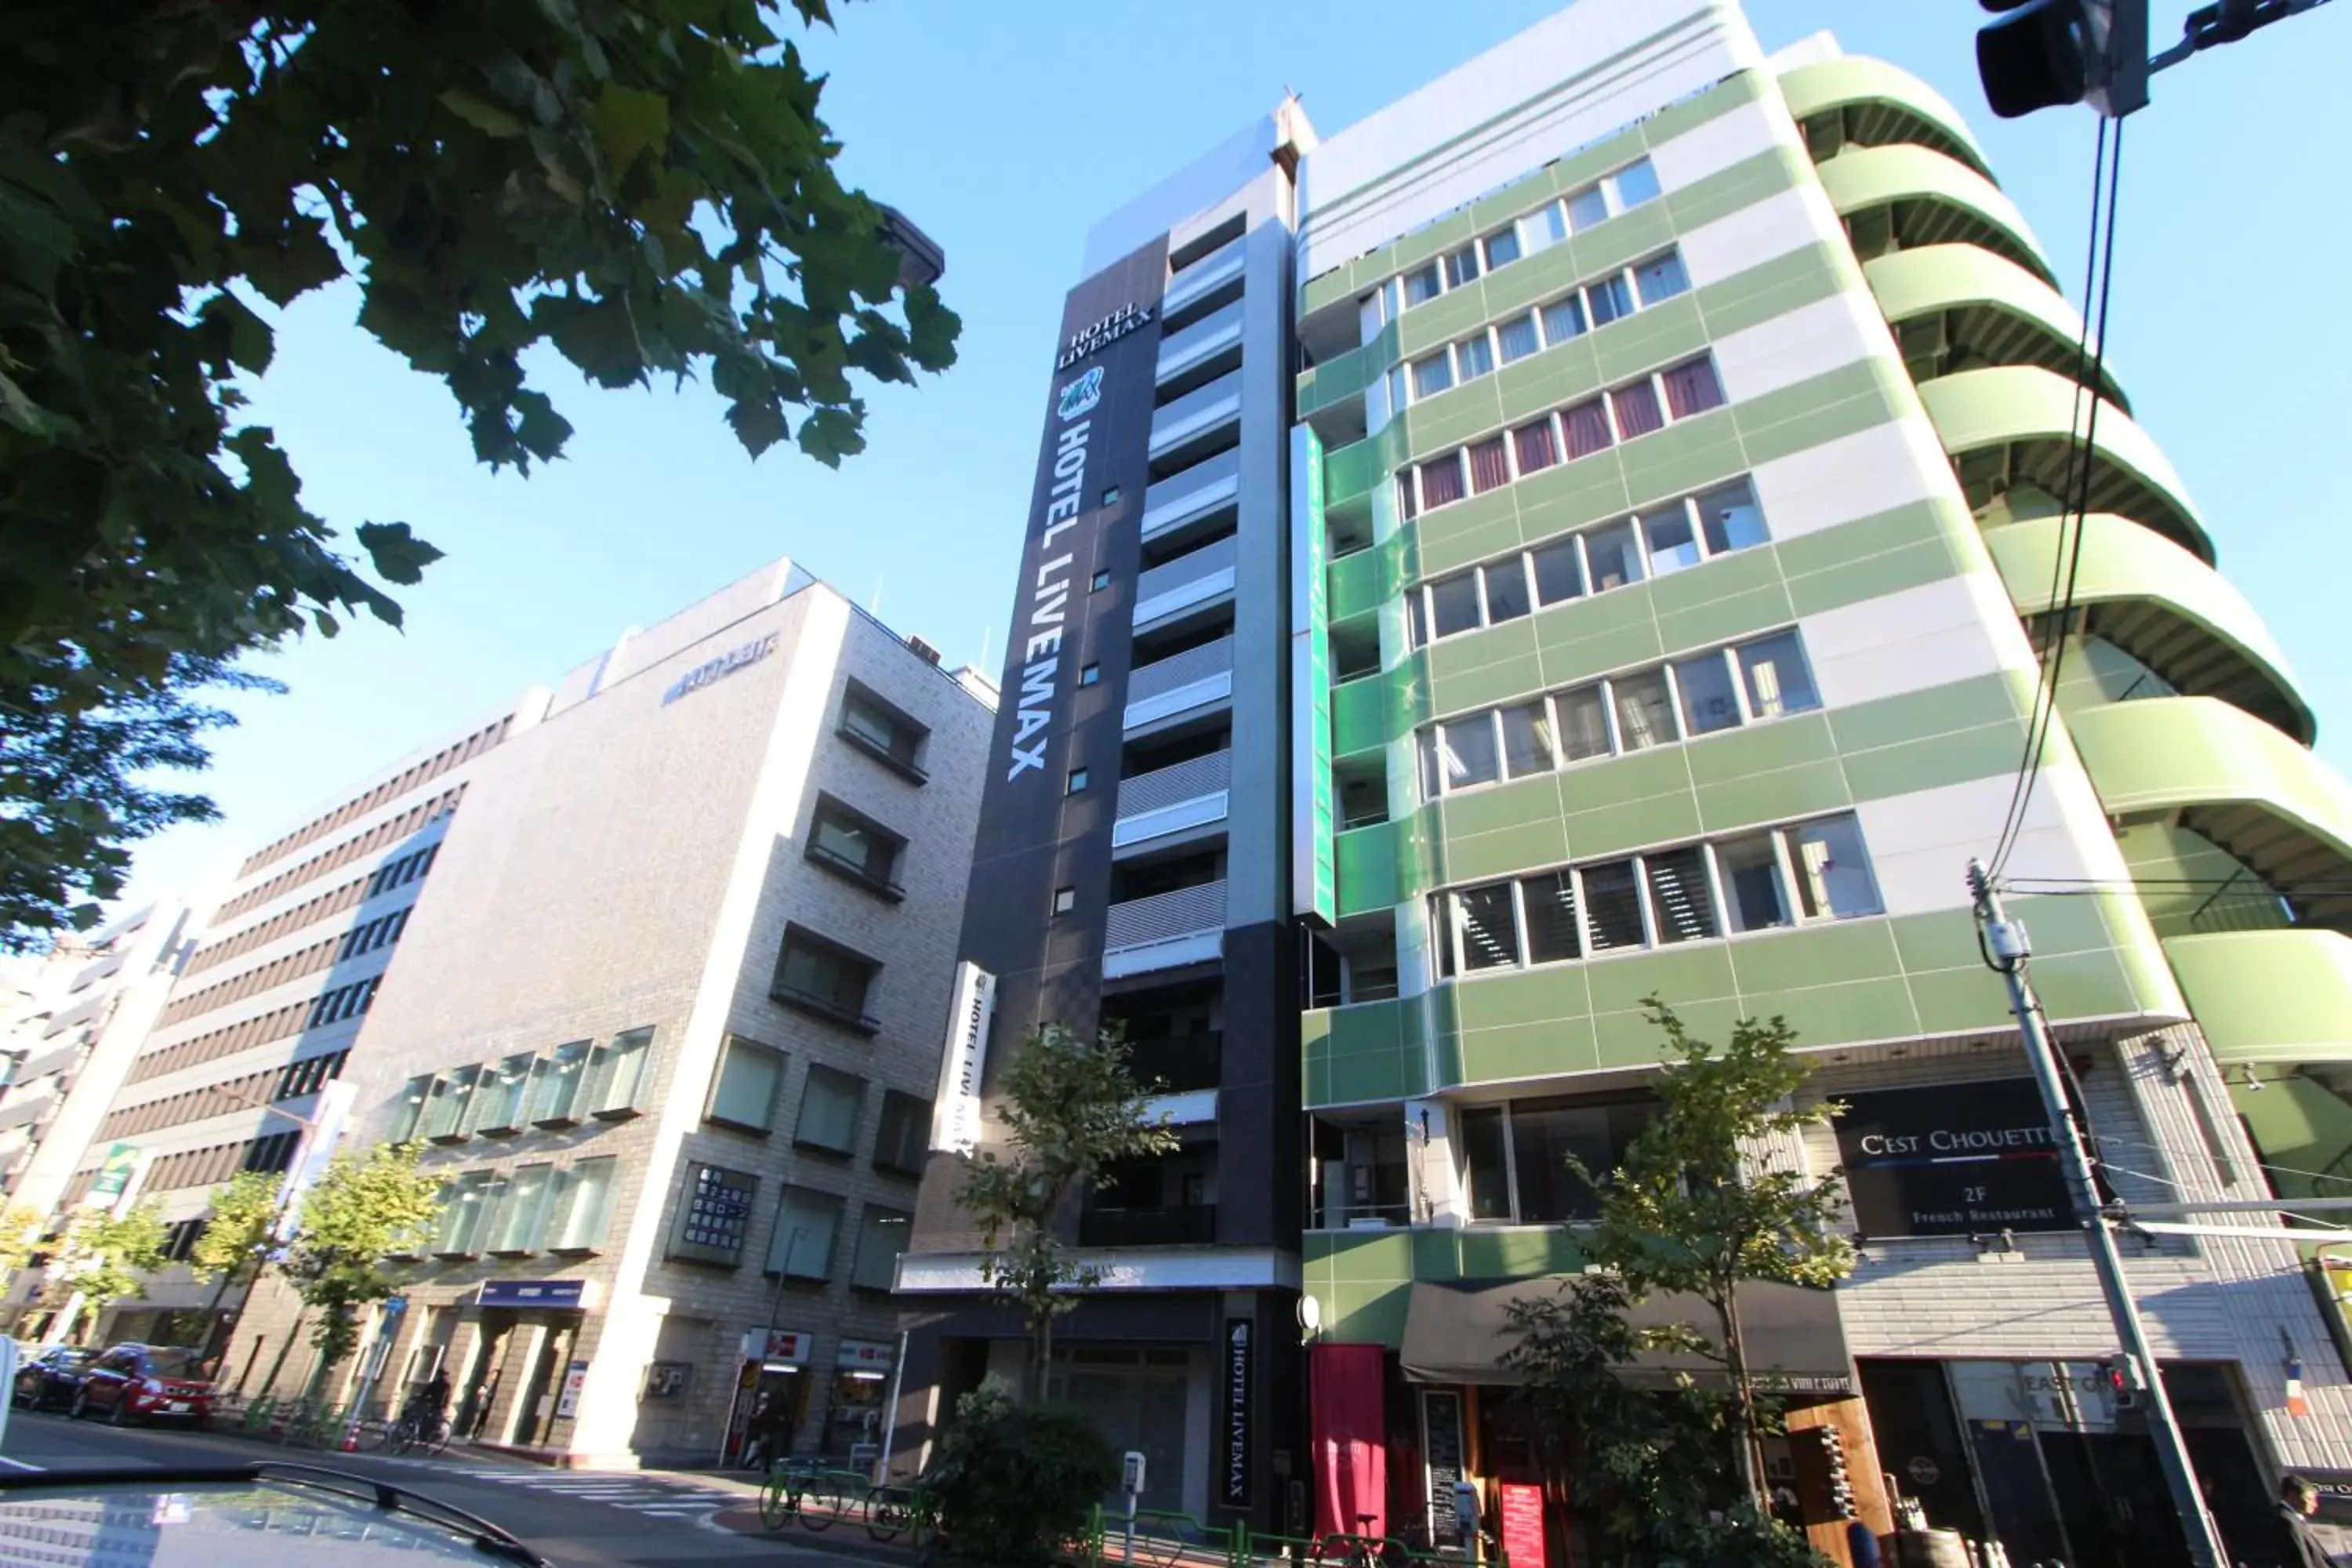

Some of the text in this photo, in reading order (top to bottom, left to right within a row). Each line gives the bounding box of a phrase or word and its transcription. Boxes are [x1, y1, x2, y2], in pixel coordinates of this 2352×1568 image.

[1071, 300, 1138, 348] HOTEL
[1043, 419, 1091, 550] HOTEL
[967, 997, 982, 1051] HOTEL
[1861, 1134, 1919, 1156] C'EST
[1911, 1206, 2055, 1225] French Restaurant
[1963, 1185, 1987, 1203] 2F
[1232, 1347, 1246, 1408] HOTEL
